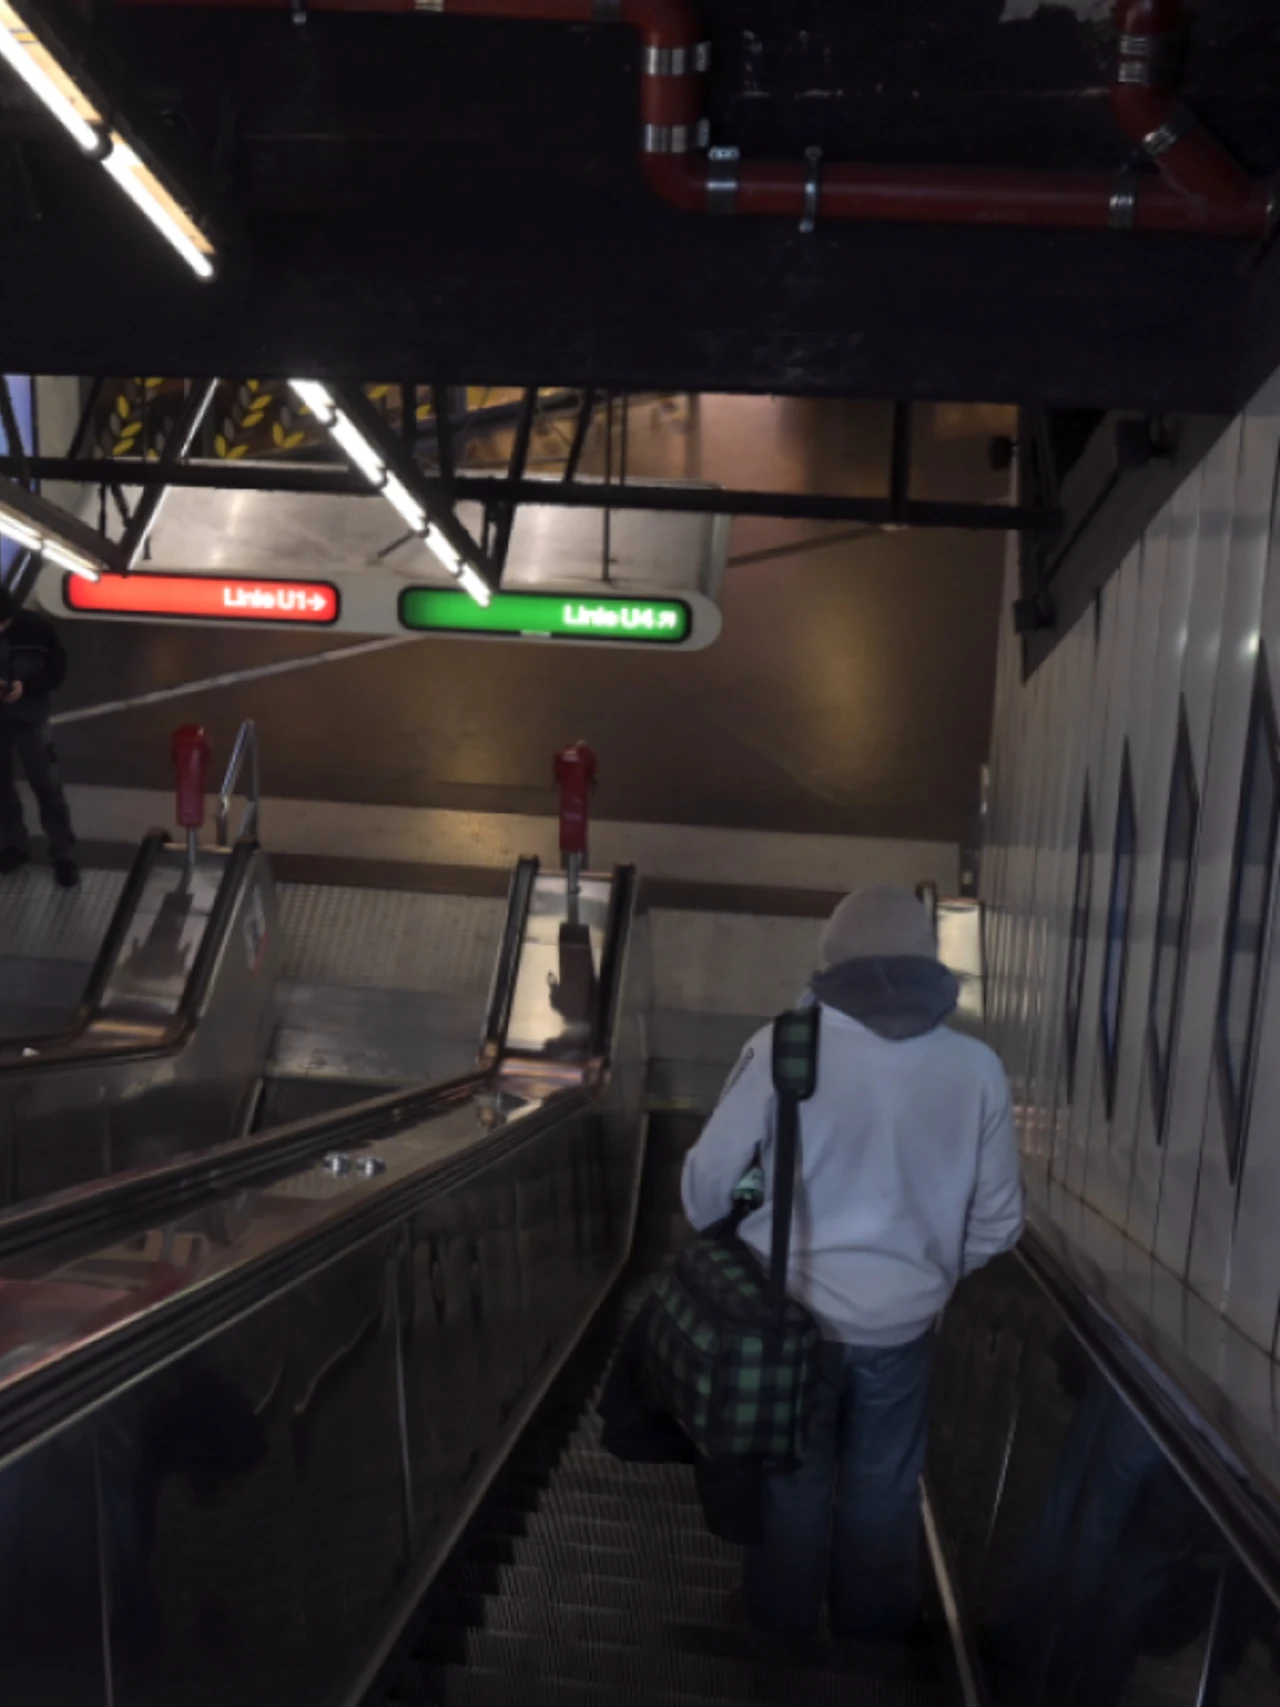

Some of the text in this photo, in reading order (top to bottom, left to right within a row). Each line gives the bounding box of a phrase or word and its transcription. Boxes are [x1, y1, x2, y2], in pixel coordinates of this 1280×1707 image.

[224, 588, 306, 611] Linie U1
[563, 604, 653, 629] Linie U4
